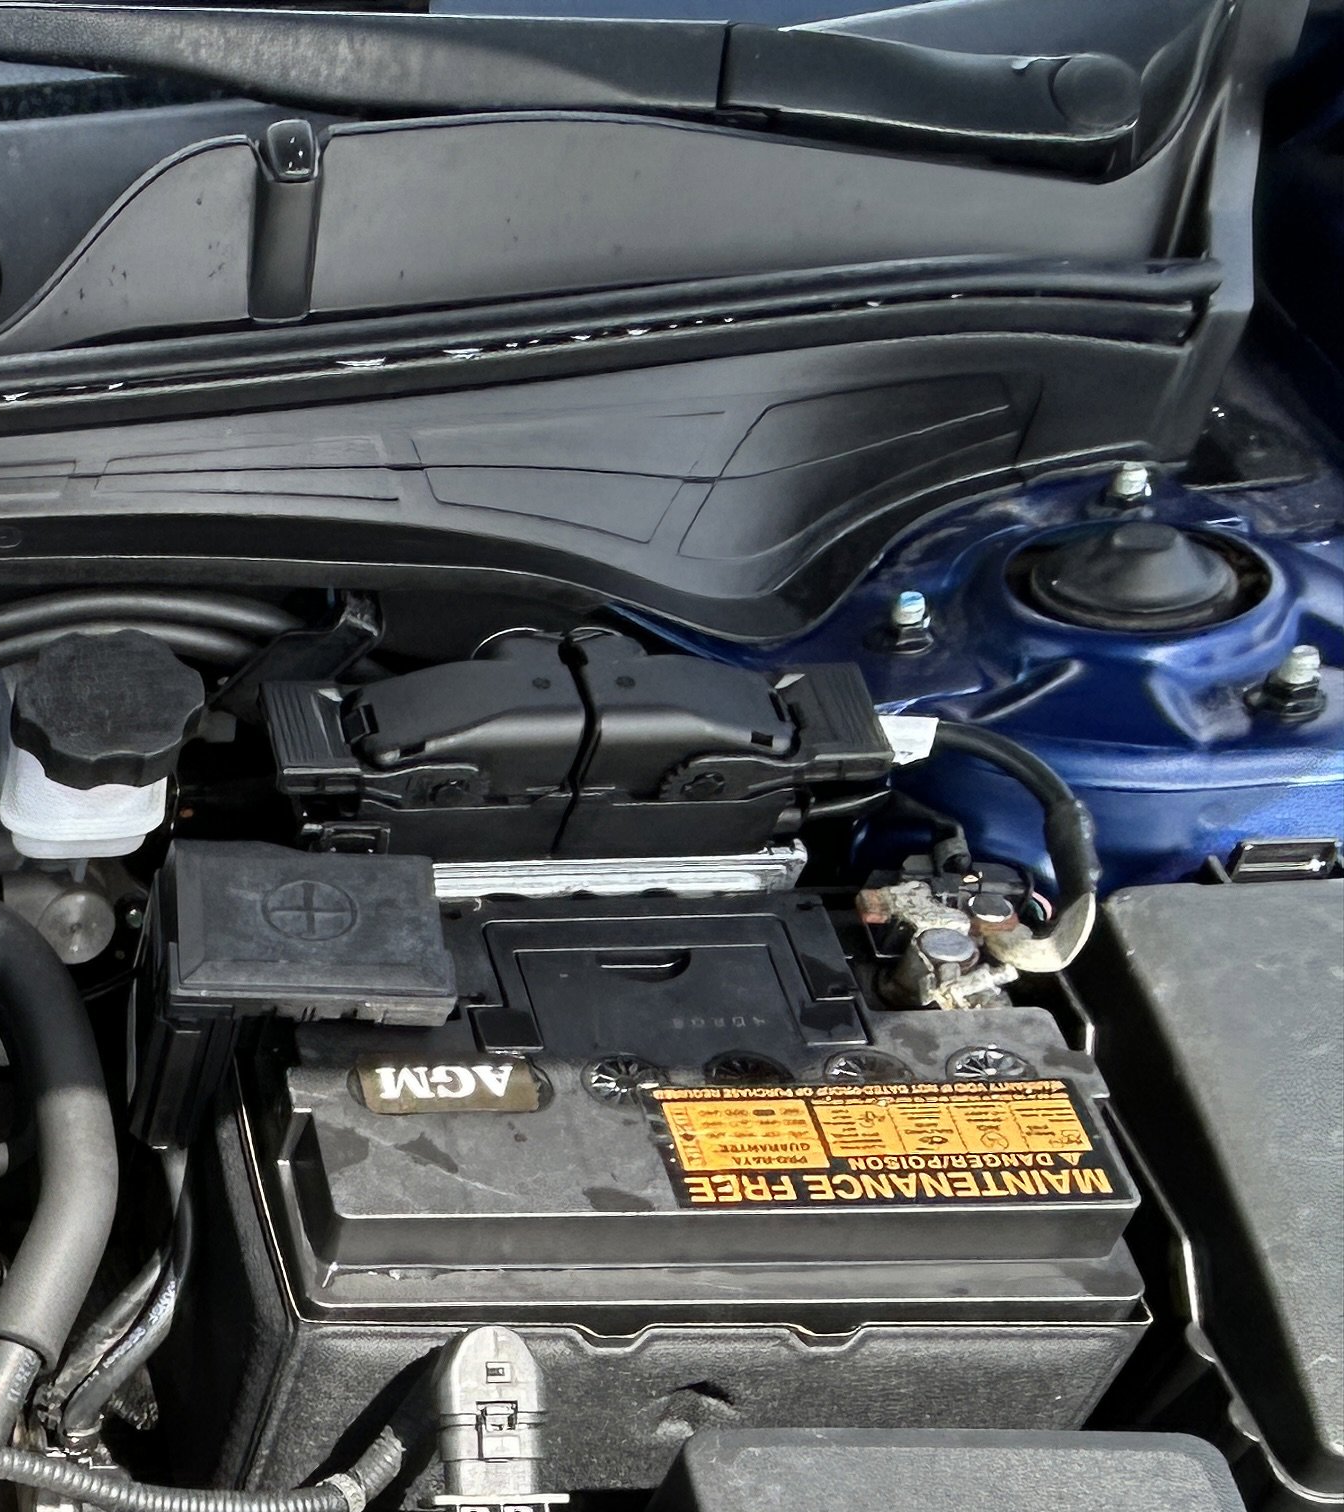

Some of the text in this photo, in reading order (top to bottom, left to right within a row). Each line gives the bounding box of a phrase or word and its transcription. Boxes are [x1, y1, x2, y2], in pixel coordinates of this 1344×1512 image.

[375, 1065, 514, 1099] AGM
[723, 1087, 794, 1098] PURCHASE
[716, 1143, 810, 1154] GUARANTEE
[848, 1153, 1054, 1171] DANGER/POISON
[683, 1168, 1113, 1203] MAINTENANCE FREE
